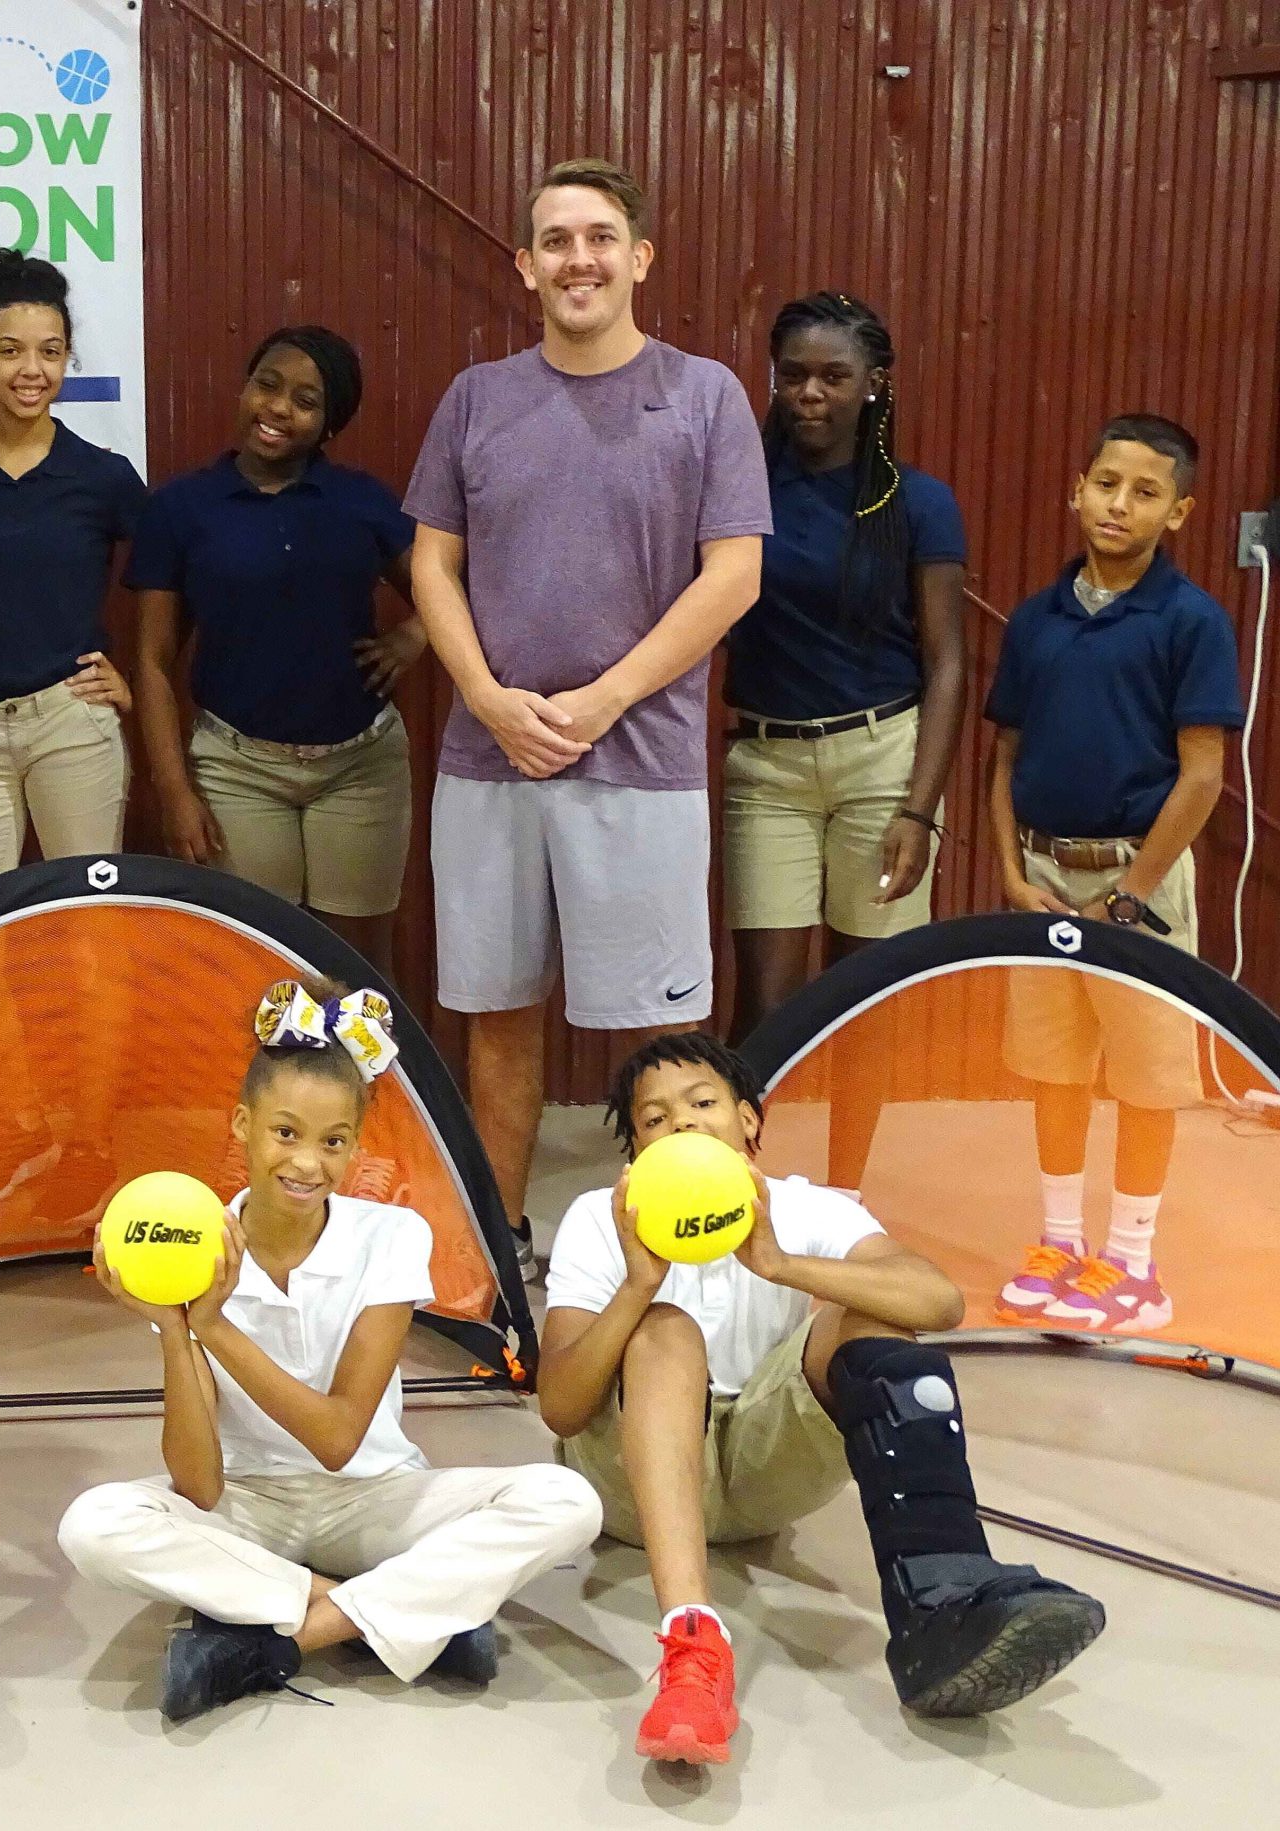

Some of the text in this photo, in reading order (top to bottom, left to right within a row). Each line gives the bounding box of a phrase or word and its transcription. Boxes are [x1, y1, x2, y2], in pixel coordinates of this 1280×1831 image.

[123, 1219, 203, 1245] US Games
[674, 1203, 746, 1239] US Games
